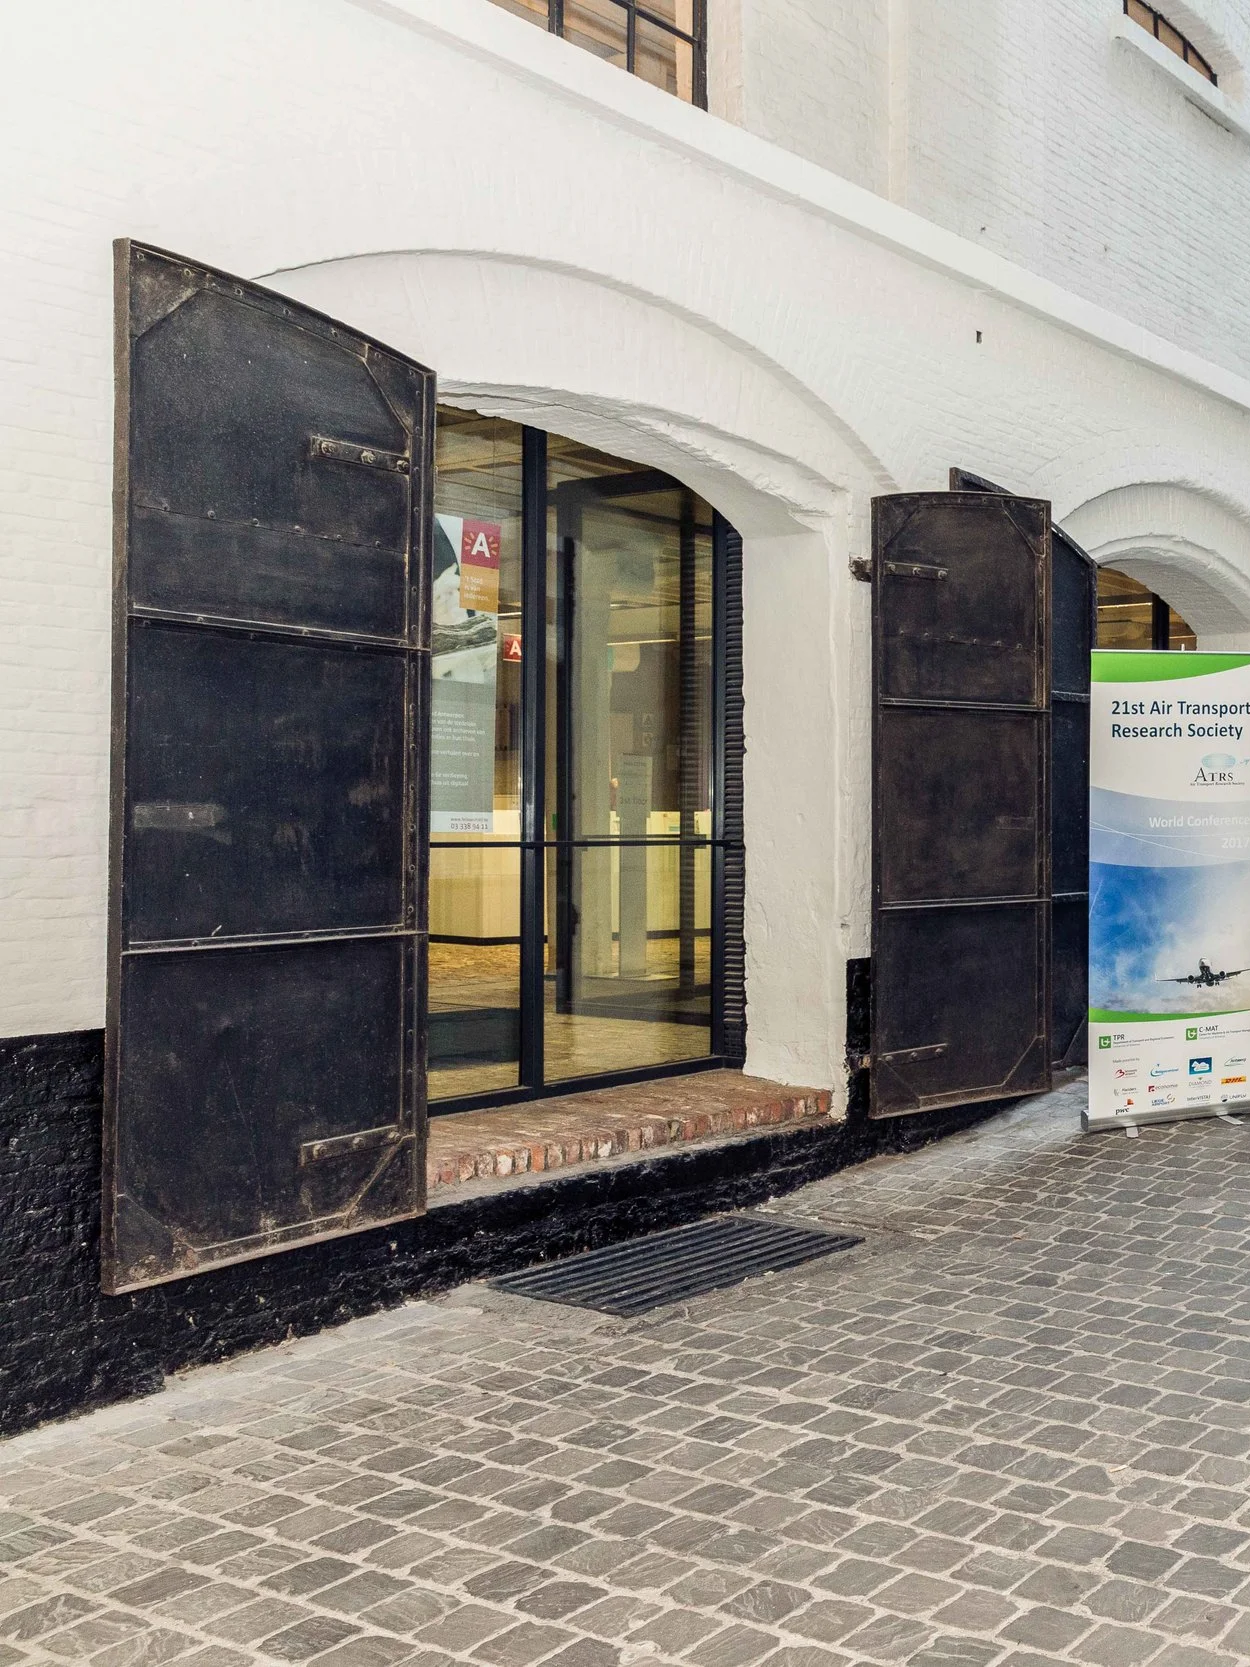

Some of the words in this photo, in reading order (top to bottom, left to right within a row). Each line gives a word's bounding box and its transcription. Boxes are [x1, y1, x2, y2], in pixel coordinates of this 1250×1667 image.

[1111, 701, 1145, 715] 21st
[1150, 700, 1173, 715] Air
[1177, 701, 1250, 718] Transport
[1111, 723, 1182, 738] Research
[1187, 723, 1243, 740] Society
[1194, 767, 1234, 782] ATRS
[1149, 816, 1184, 828] World
[1187, 814, 1250, 827] Conference
[1221, 837, 1250, 849] 2017
[1199, 1025, 1219, 1033] C-MAT
